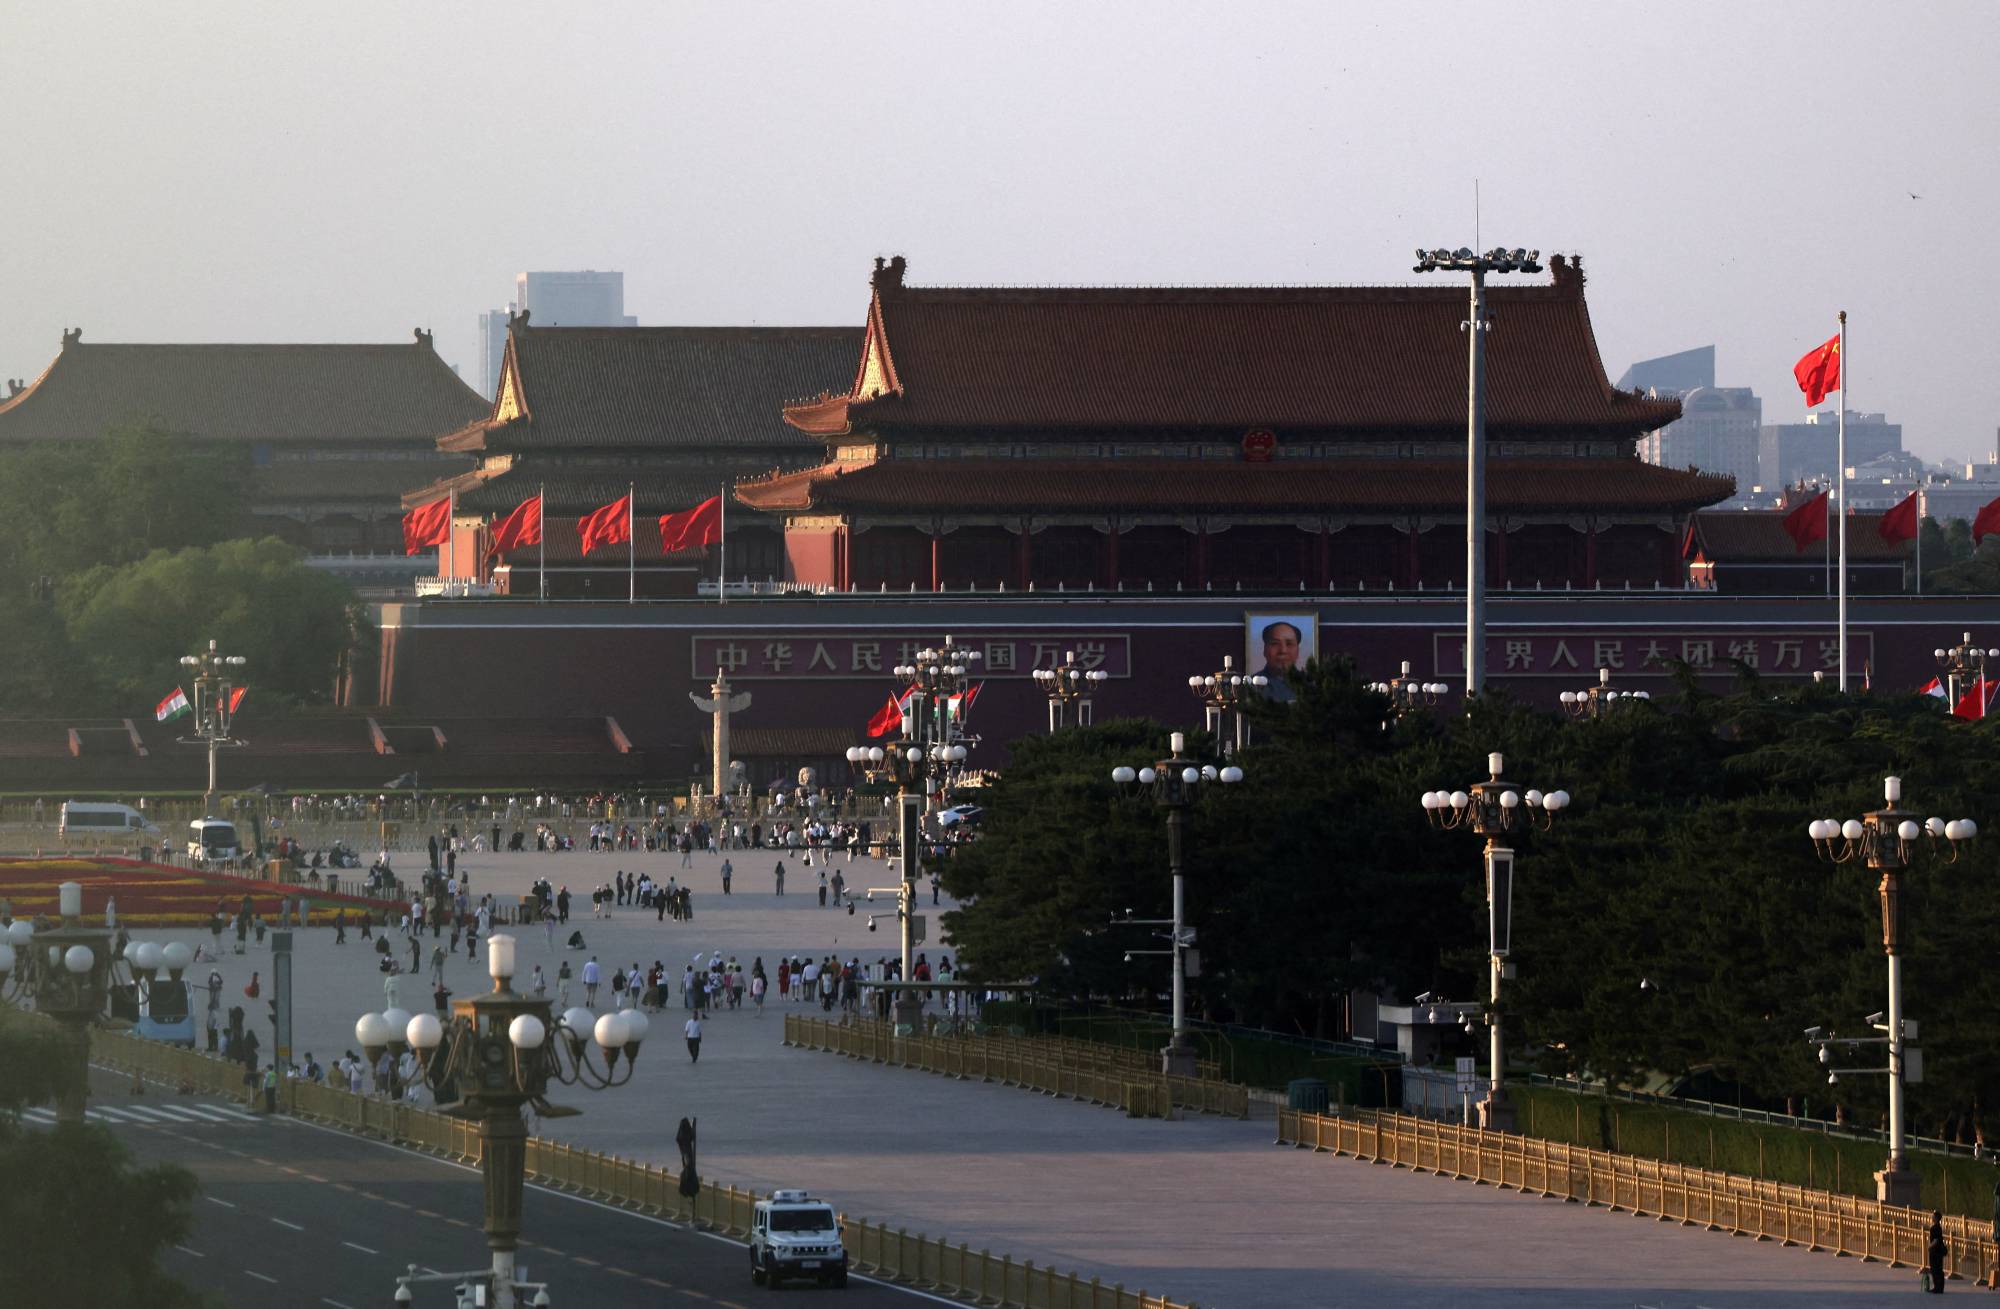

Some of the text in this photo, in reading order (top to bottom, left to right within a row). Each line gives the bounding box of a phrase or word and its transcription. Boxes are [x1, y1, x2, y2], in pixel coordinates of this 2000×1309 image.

[716, 642, 1106, 672] 中华人民共国万岁
[1460, 639, 1849, 669] 界人民大团结万岁
